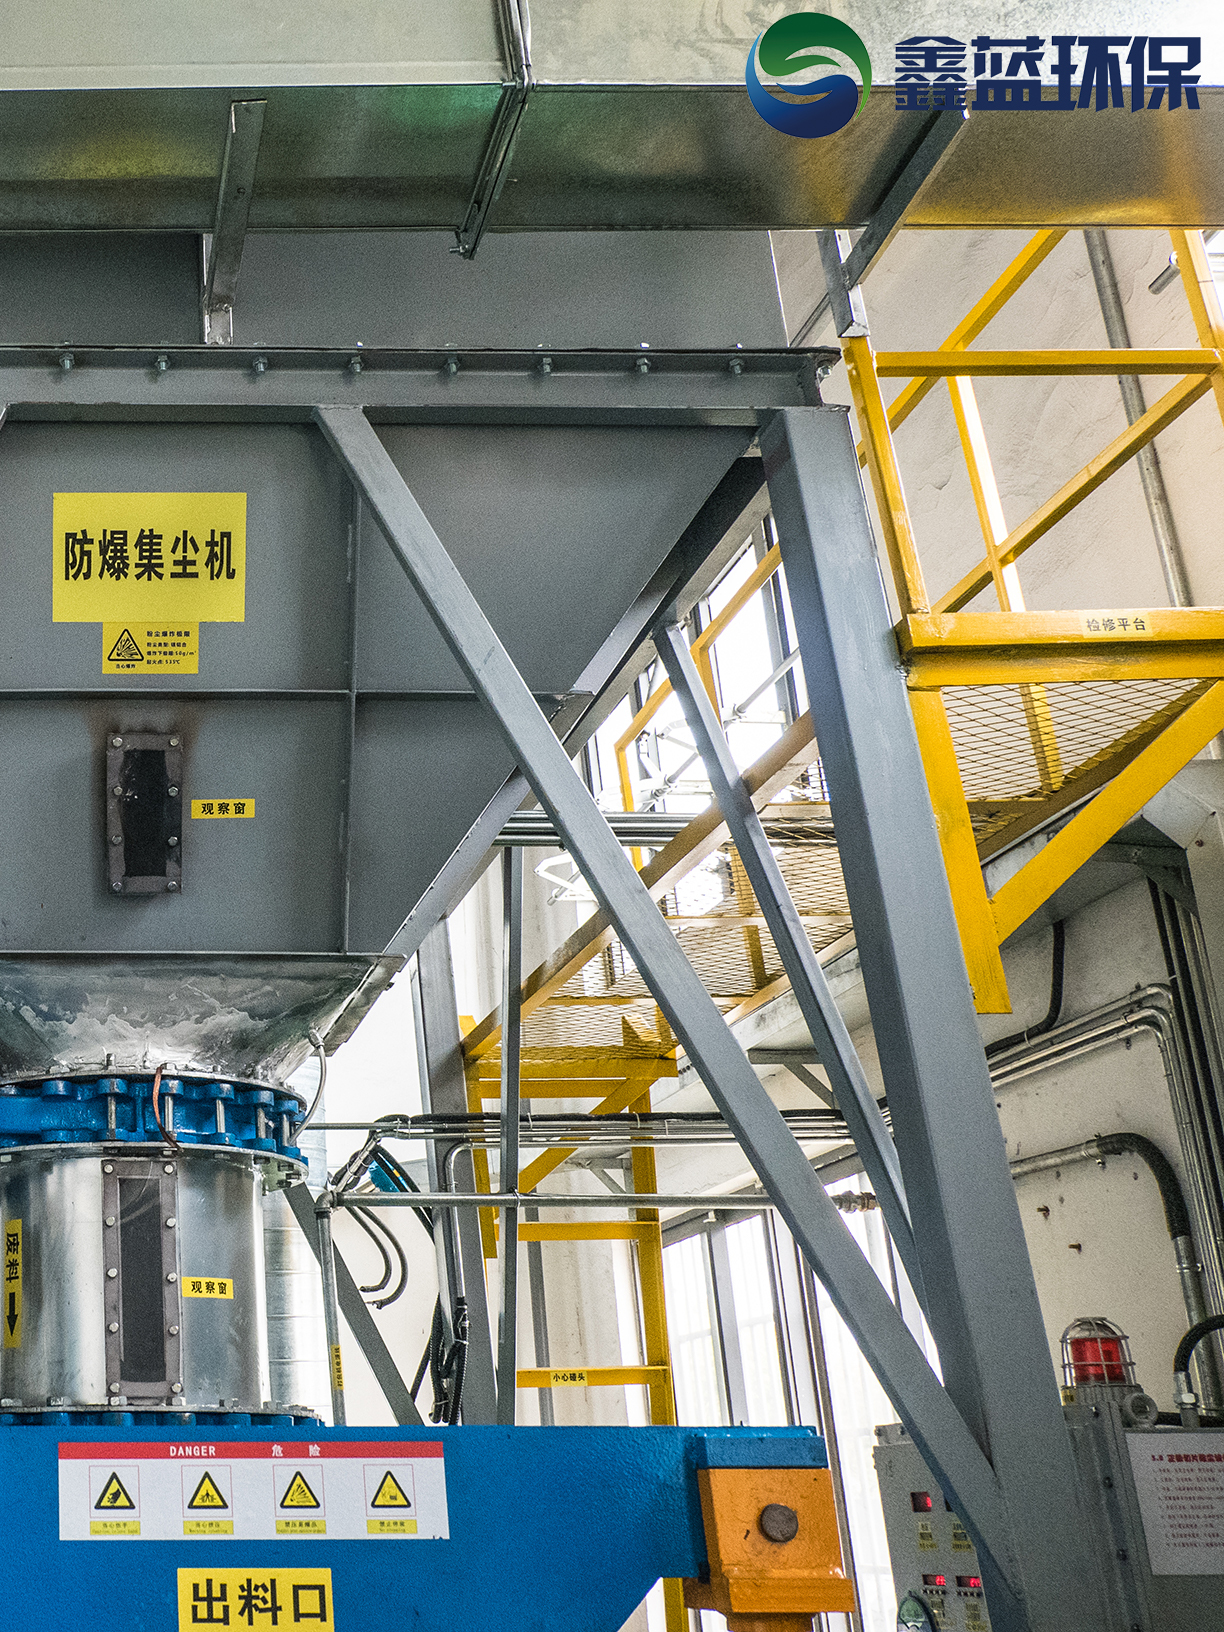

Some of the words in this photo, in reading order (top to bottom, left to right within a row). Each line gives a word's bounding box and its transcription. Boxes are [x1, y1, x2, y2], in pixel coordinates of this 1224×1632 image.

[64, 528, 236, 581] 防爆集尘机
[1086, 617, 1146, 632] 检修平台
[201, 801, 246, 815] 观察窗
[5, 1232, 20, 1283] 废料
[190, 1280, 228, 1295] 观察窗
[553, 1372, 586, 1382] 小心碰头
[169, 1445, 216, 1457] DANGER
[191, 1578, 327, 1626] 出料口
